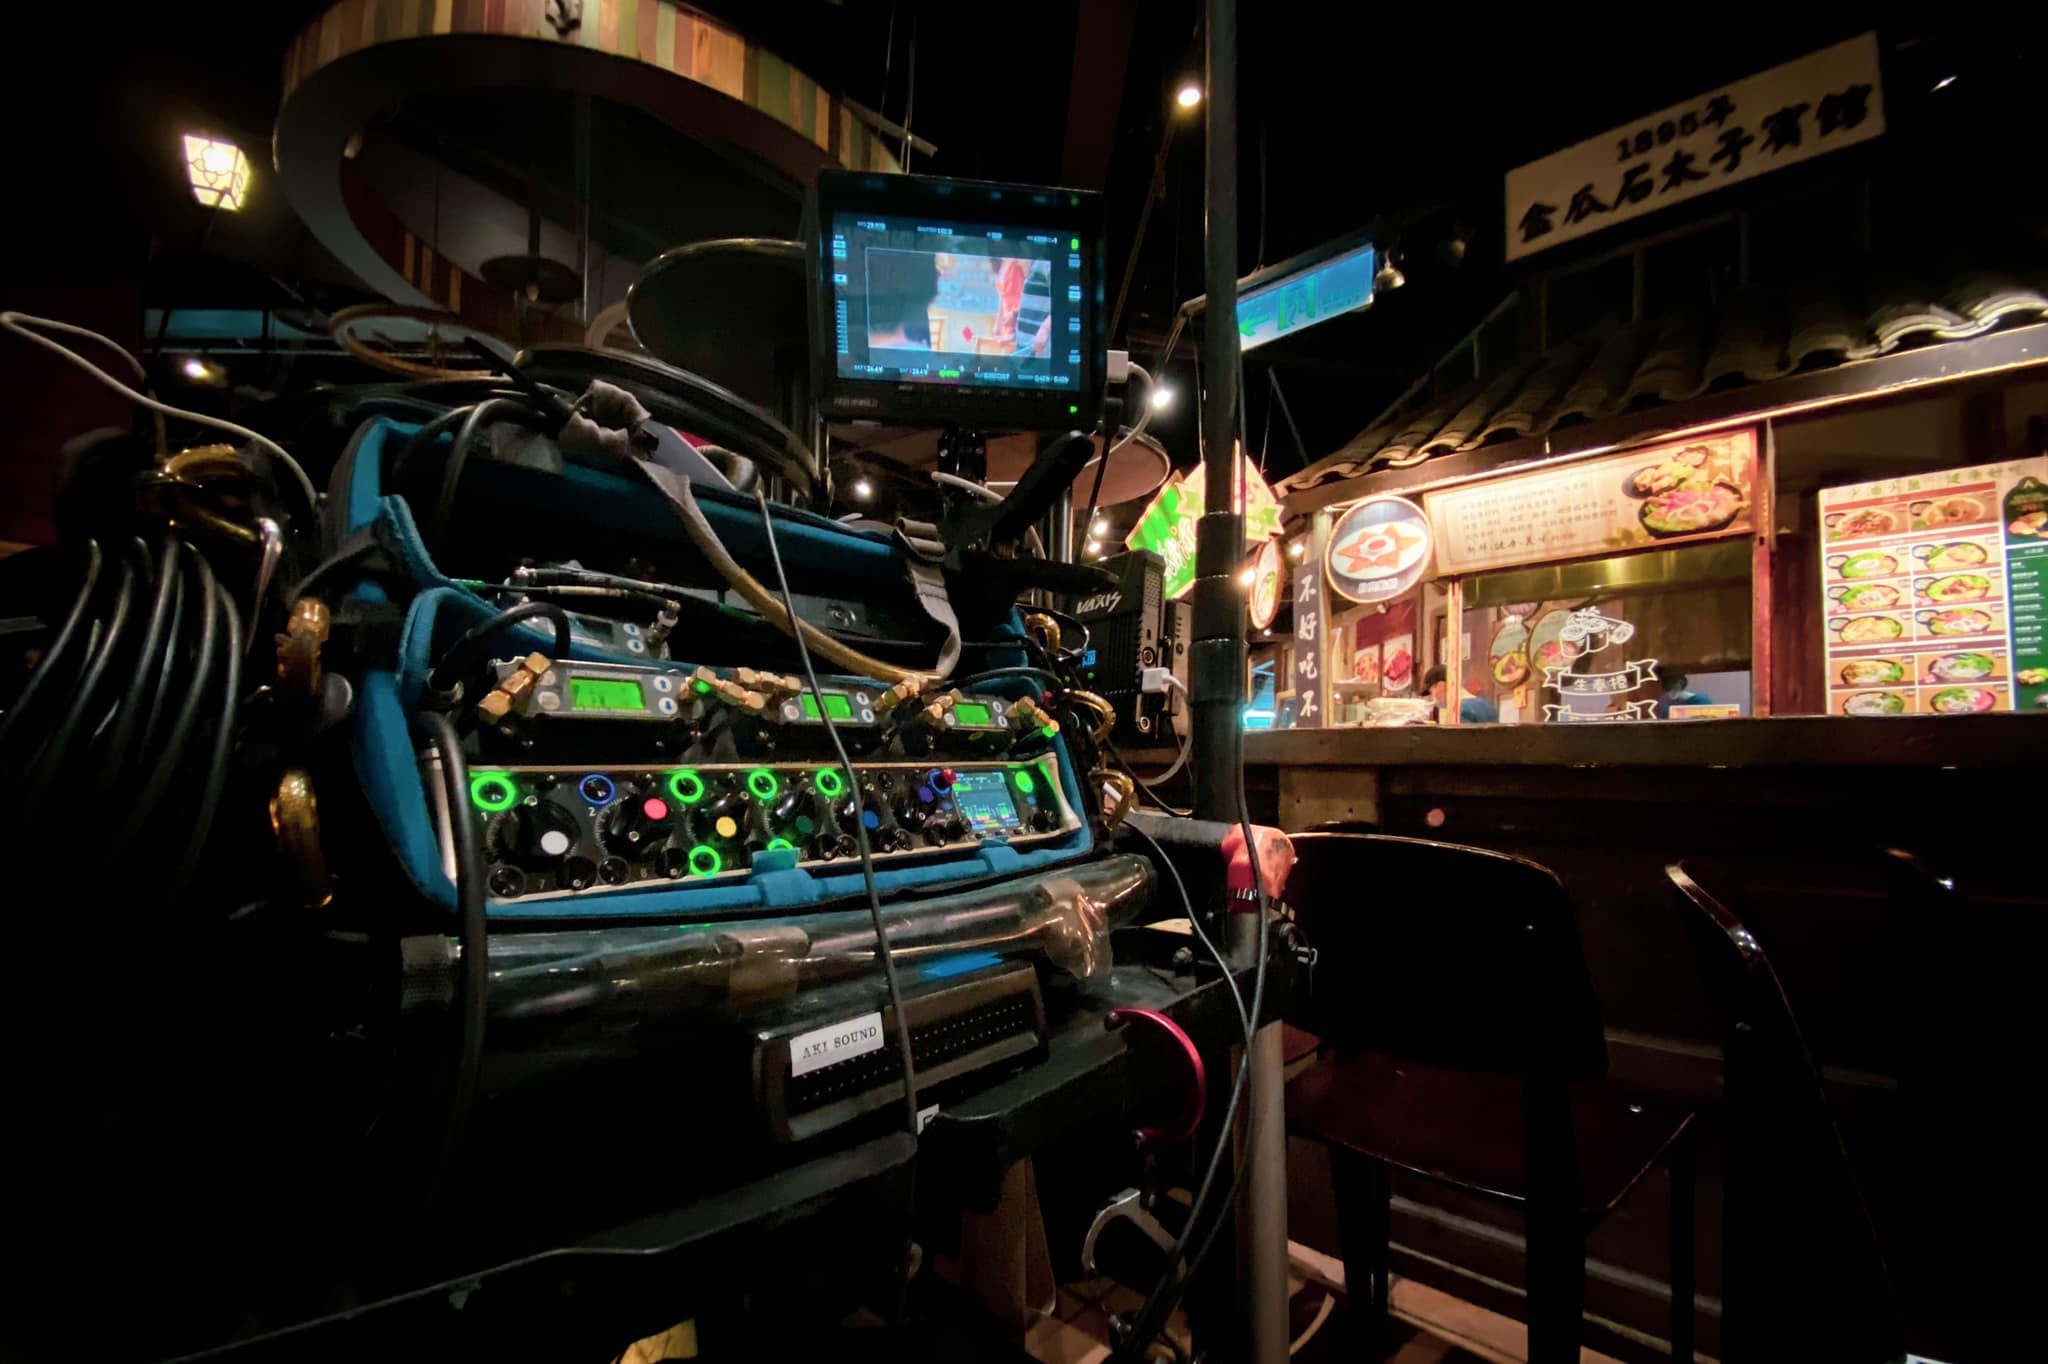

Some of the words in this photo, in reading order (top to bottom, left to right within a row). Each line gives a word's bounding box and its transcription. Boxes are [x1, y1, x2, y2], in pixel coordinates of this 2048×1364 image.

[1615, 93, 1737, 162] 1895年
[1076, 592, 1122, 614] VAXIS
[1298, 574, 1318, 717] 不好吃不
[587, 806, 597, 816] 2
[802, 1041, 828, 1059] AKI
[833, 1026, 878, 1049] SOUND
